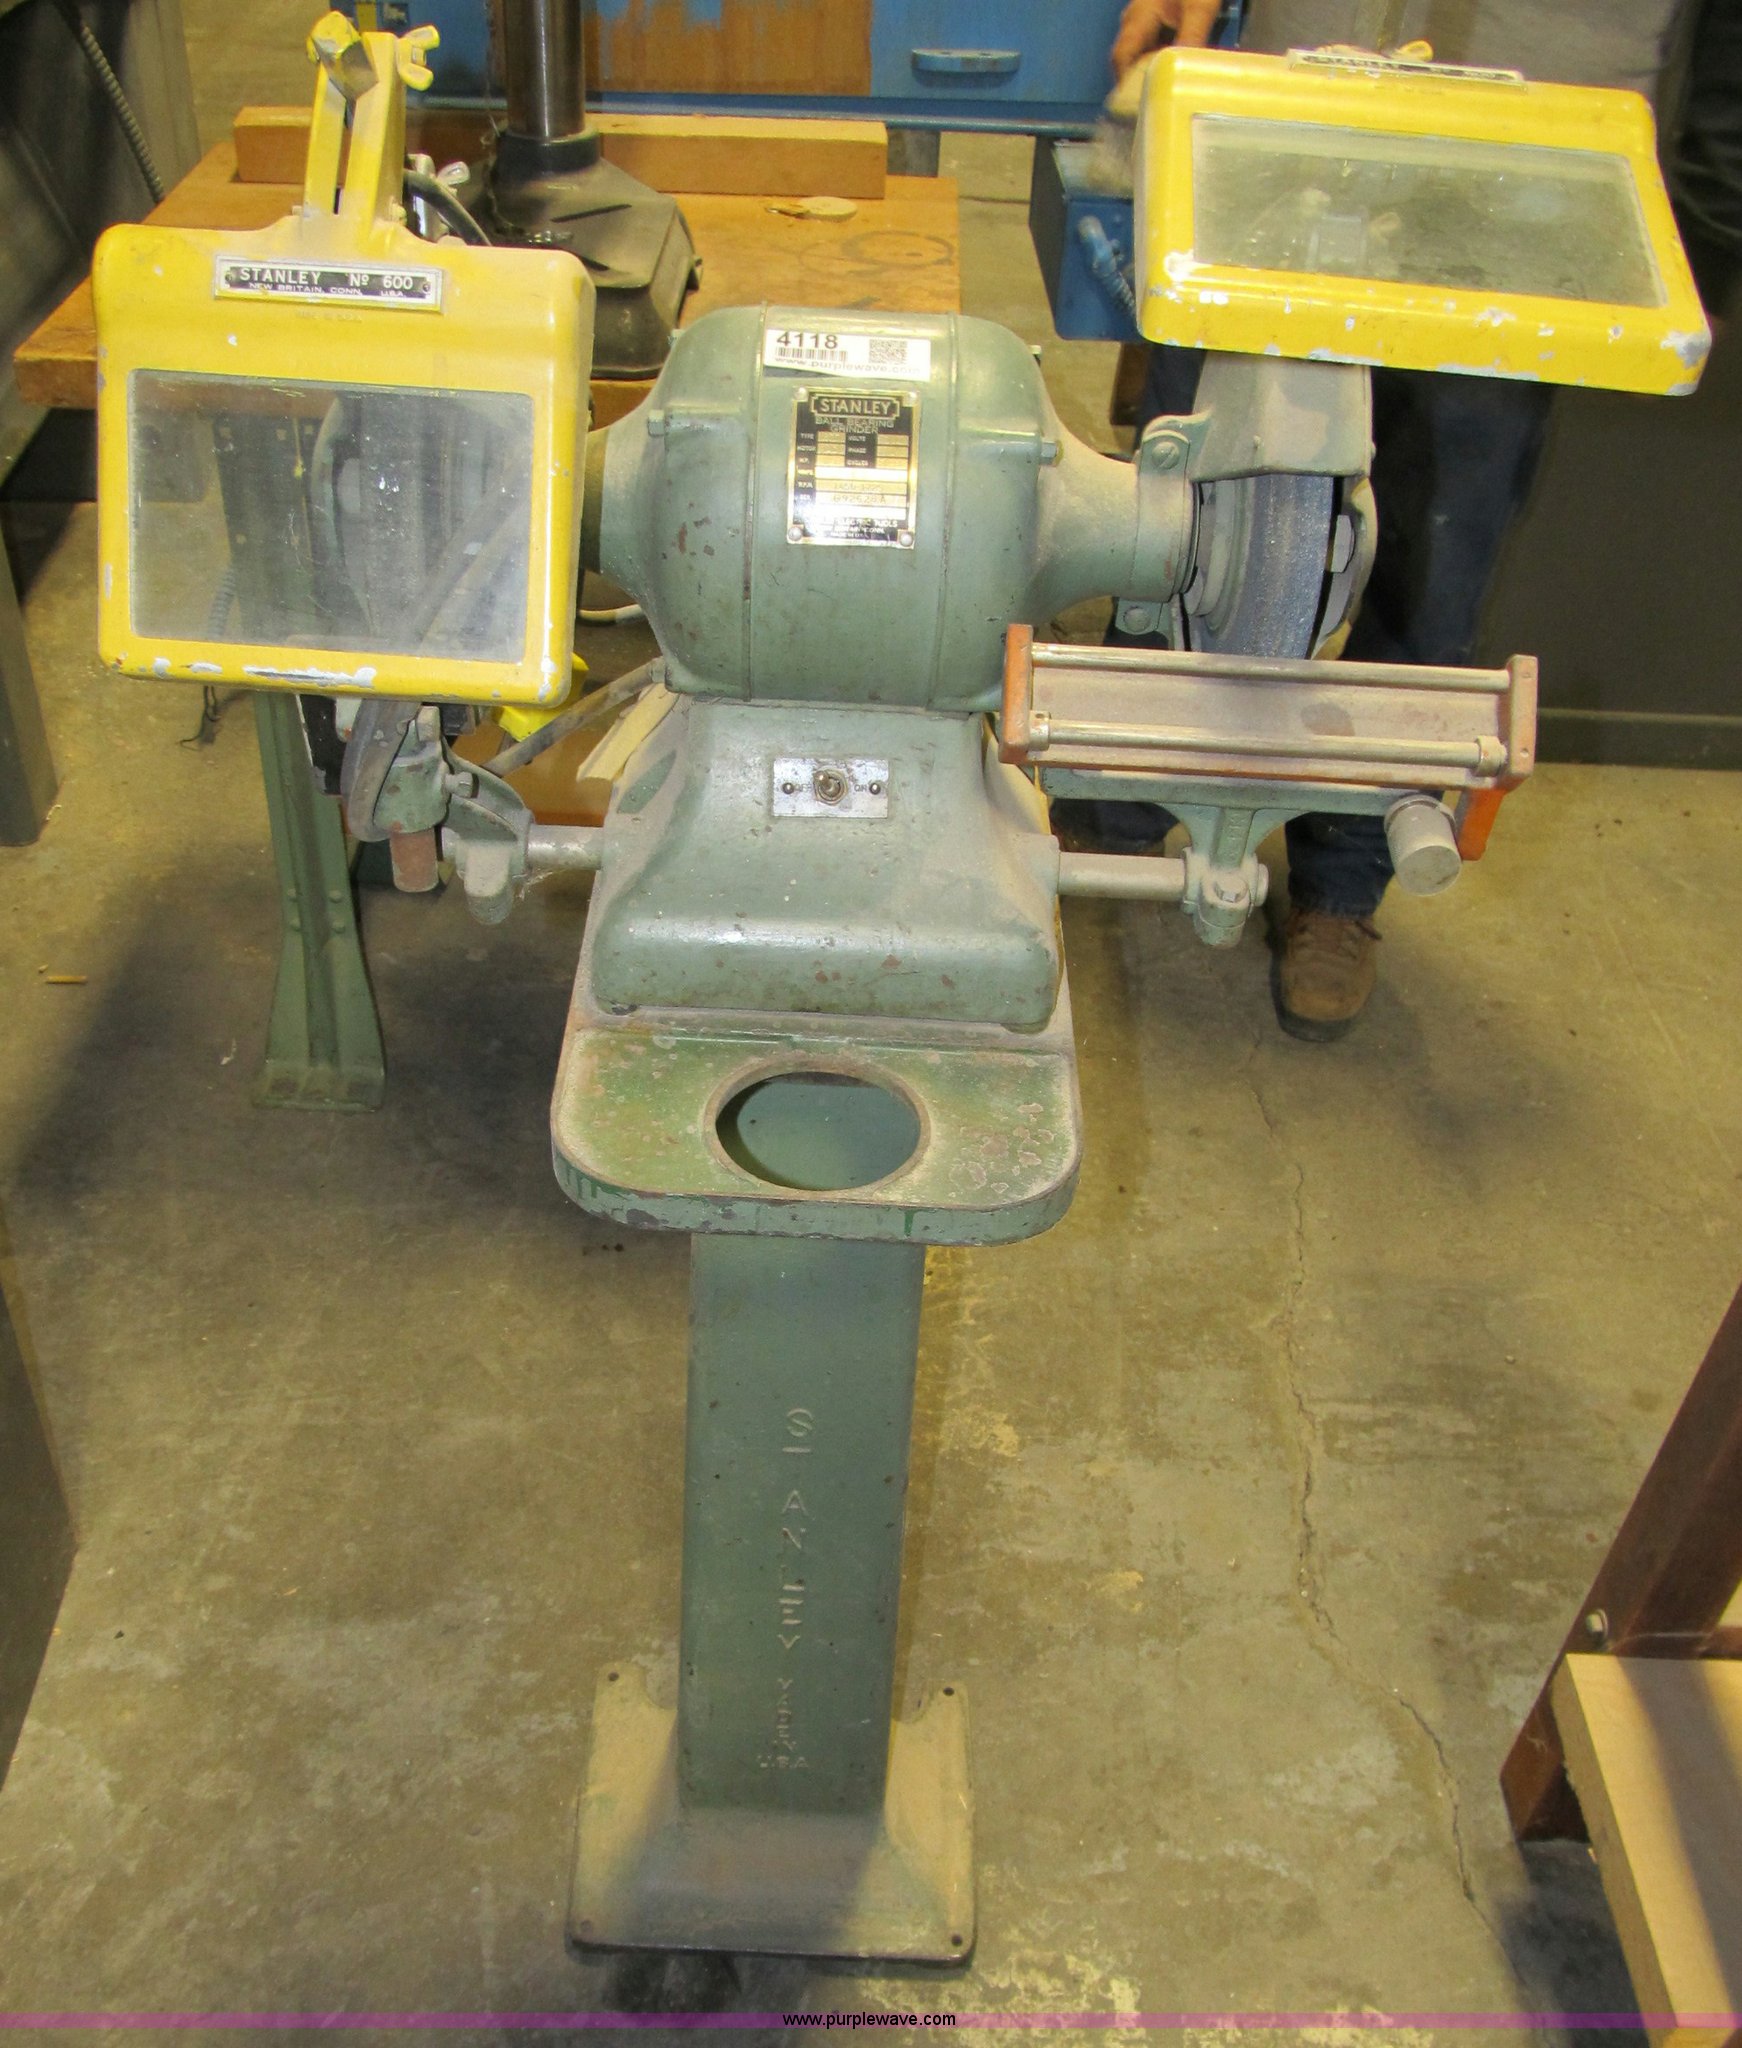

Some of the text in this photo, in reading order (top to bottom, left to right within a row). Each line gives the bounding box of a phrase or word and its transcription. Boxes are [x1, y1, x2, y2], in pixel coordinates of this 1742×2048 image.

[240, 267, 322, 285] STANLEY
[382, 275, 413, 290] 600
[249, 282, 272, 290] NEW
[776, 331, 839, 349] 4118
[774, 357, 921, 376] www.purplewave.com
[820, 398, 891, 415] STANLEY
[815, 416, 895, 429] BALL BEARING
[830, 424, 879, 434] GRINDER
